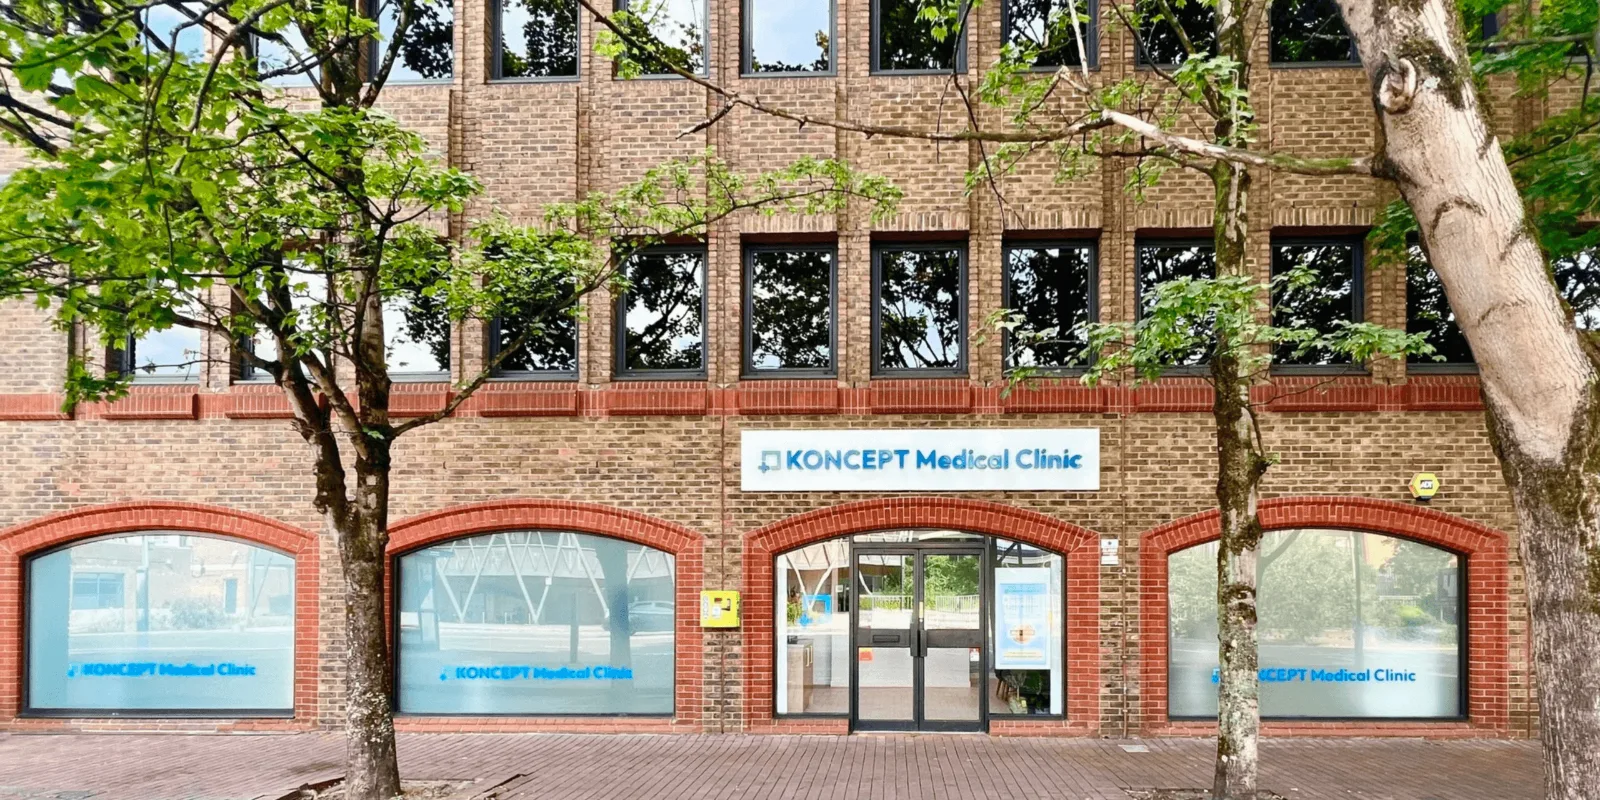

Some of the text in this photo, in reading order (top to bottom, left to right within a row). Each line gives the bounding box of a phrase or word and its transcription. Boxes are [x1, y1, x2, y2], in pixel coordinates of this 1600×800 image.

[786, 448, 1083, 470] KONCEPT Medical Clinic
[217, 663, 256, 676] Clinic
[455, 666, 530, 680] KONCEPT
[1310, 668, 1371, 682] Medical
[1373, 668, 1417, 682] Clinic
